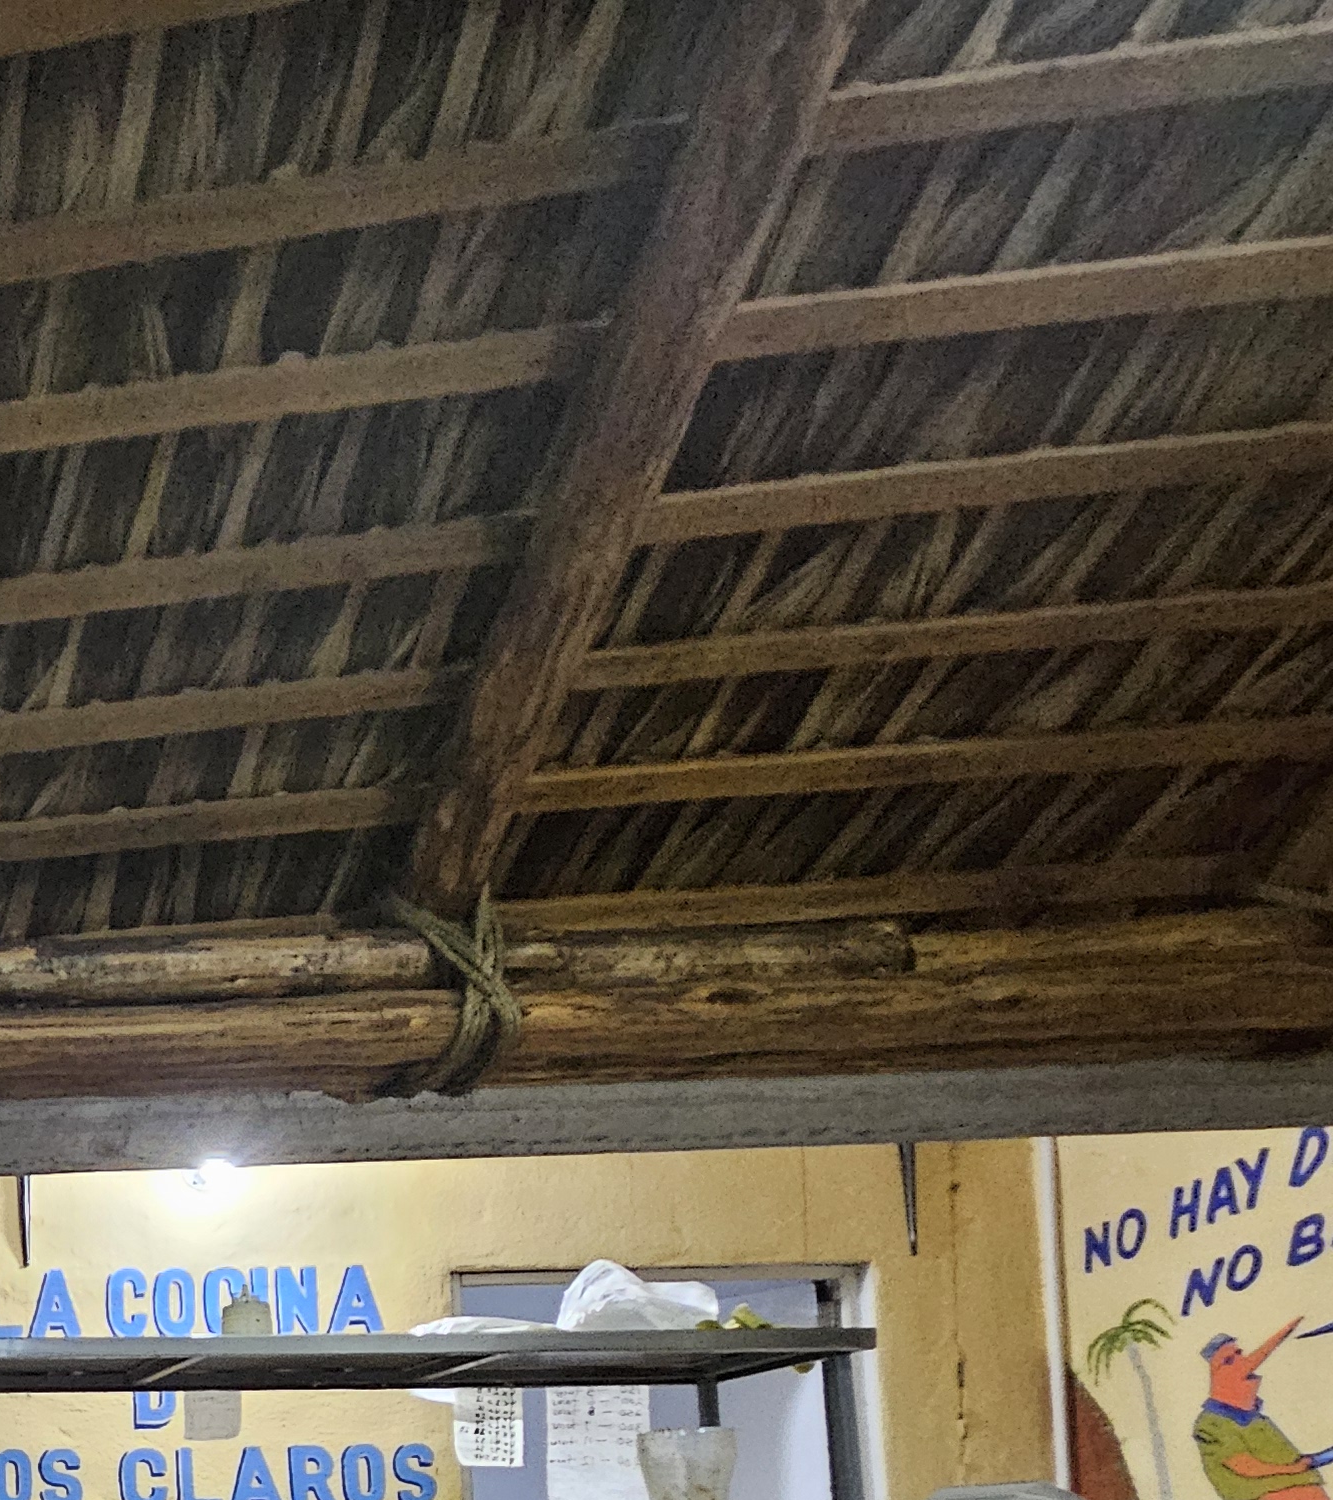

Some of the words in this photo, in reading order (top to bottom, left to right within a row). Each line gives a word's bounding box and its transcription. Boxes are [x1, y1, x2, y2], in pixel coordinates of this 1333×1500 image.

[1084, 1208, 1147, 1273] NO
[1169, 1147, 1270, 1239] HAY
[1181, 1244, 1263, 1317] NO
[1286, 1213, 1333, 1267] B
